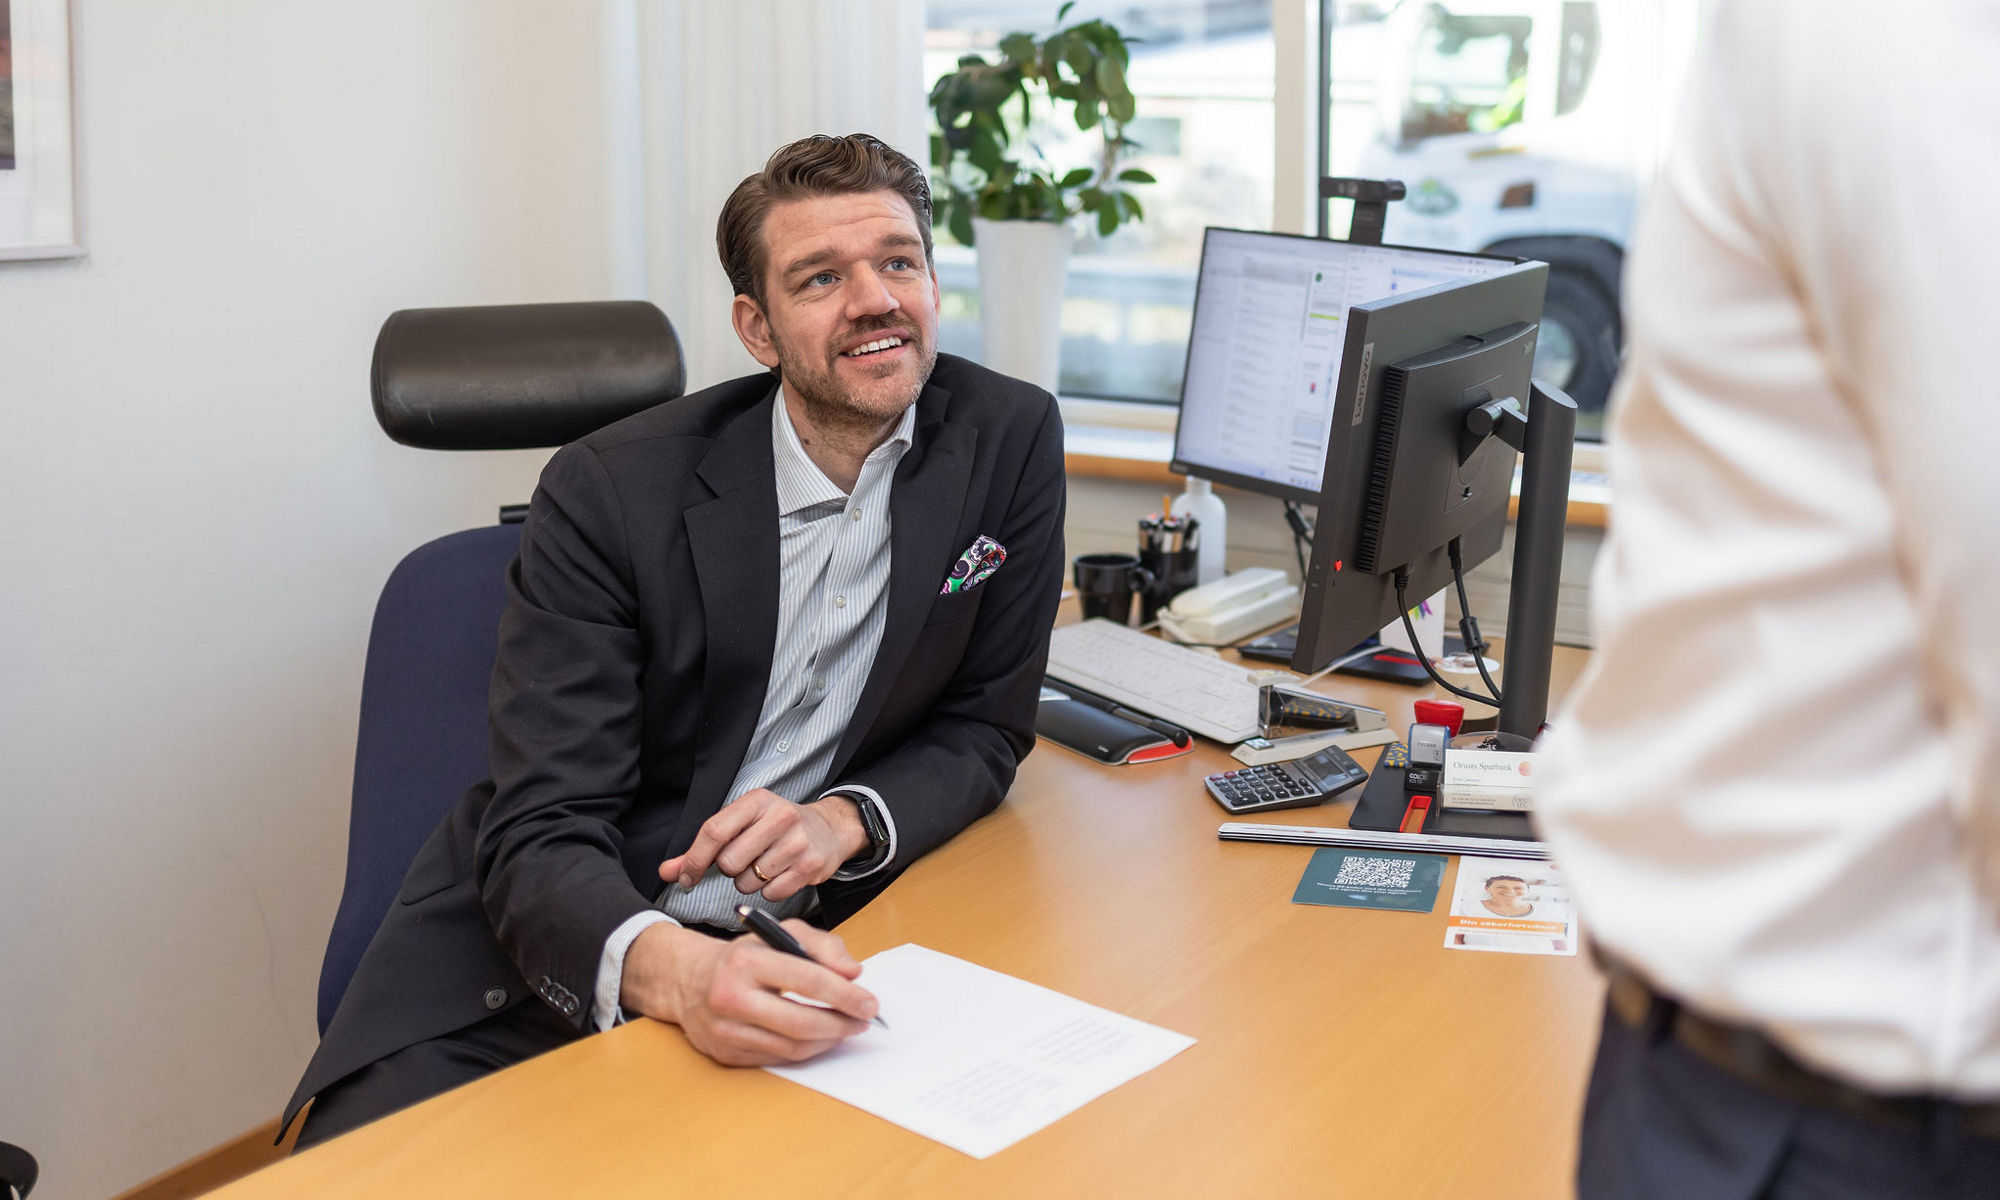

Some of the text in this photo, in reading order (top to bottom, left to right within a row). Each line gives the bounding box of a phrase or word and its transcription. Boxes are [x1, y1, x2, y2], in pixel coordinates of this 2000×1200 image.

[1354, 350, 1371, 418] Lenovo
[1453, 761, 1513, 772] Orusts Sparbank
